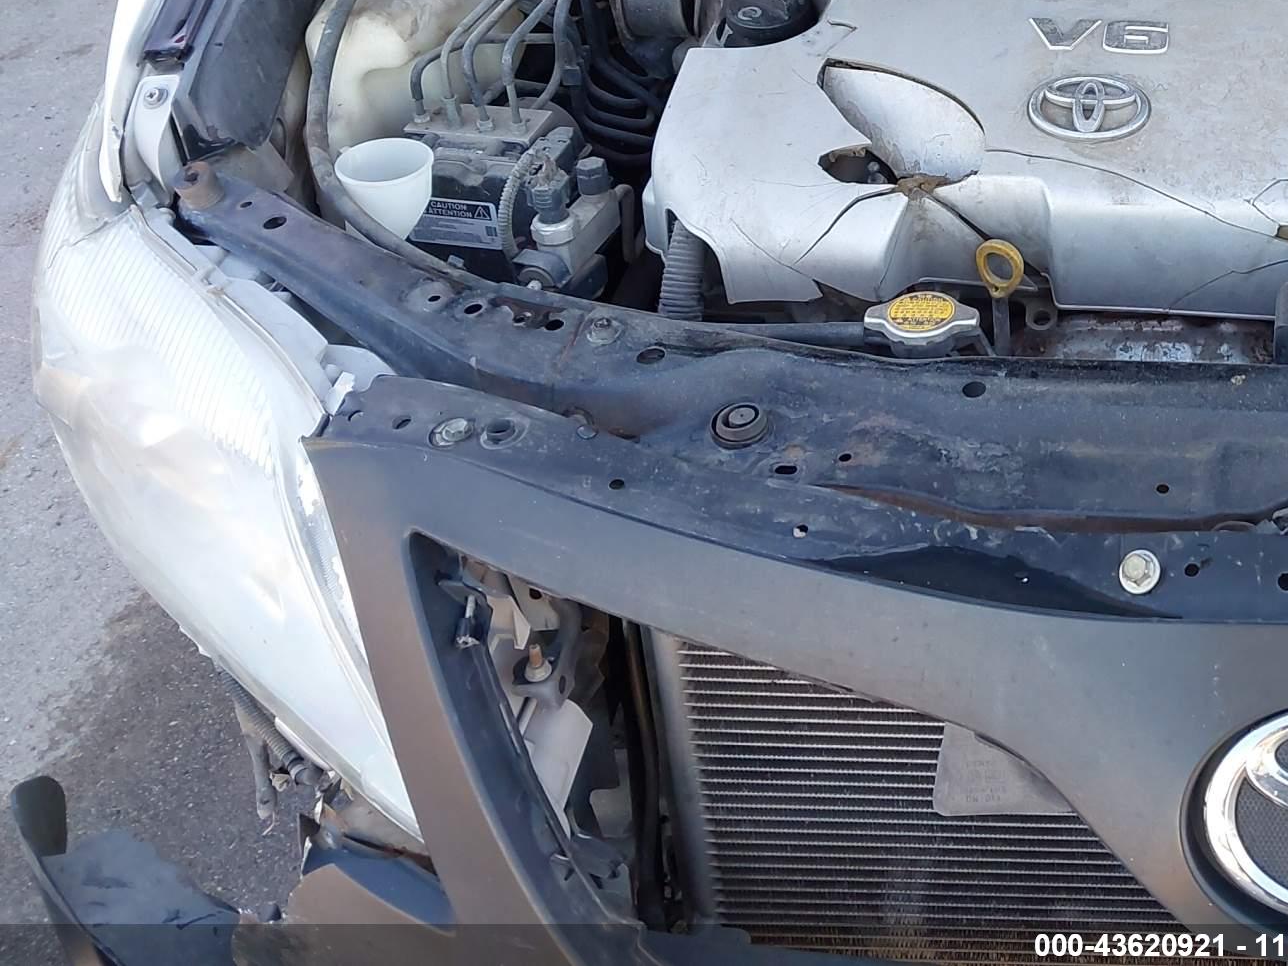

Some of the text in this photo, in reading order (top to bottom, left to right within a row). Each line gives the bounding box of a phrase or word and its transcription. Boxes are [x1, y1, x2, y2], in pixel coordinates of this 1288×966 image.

[1028, 17, 1169, 54] V6
[430, 200, 468, 211] CAUTION
[428, 206, 473, 218] ATTENTION
